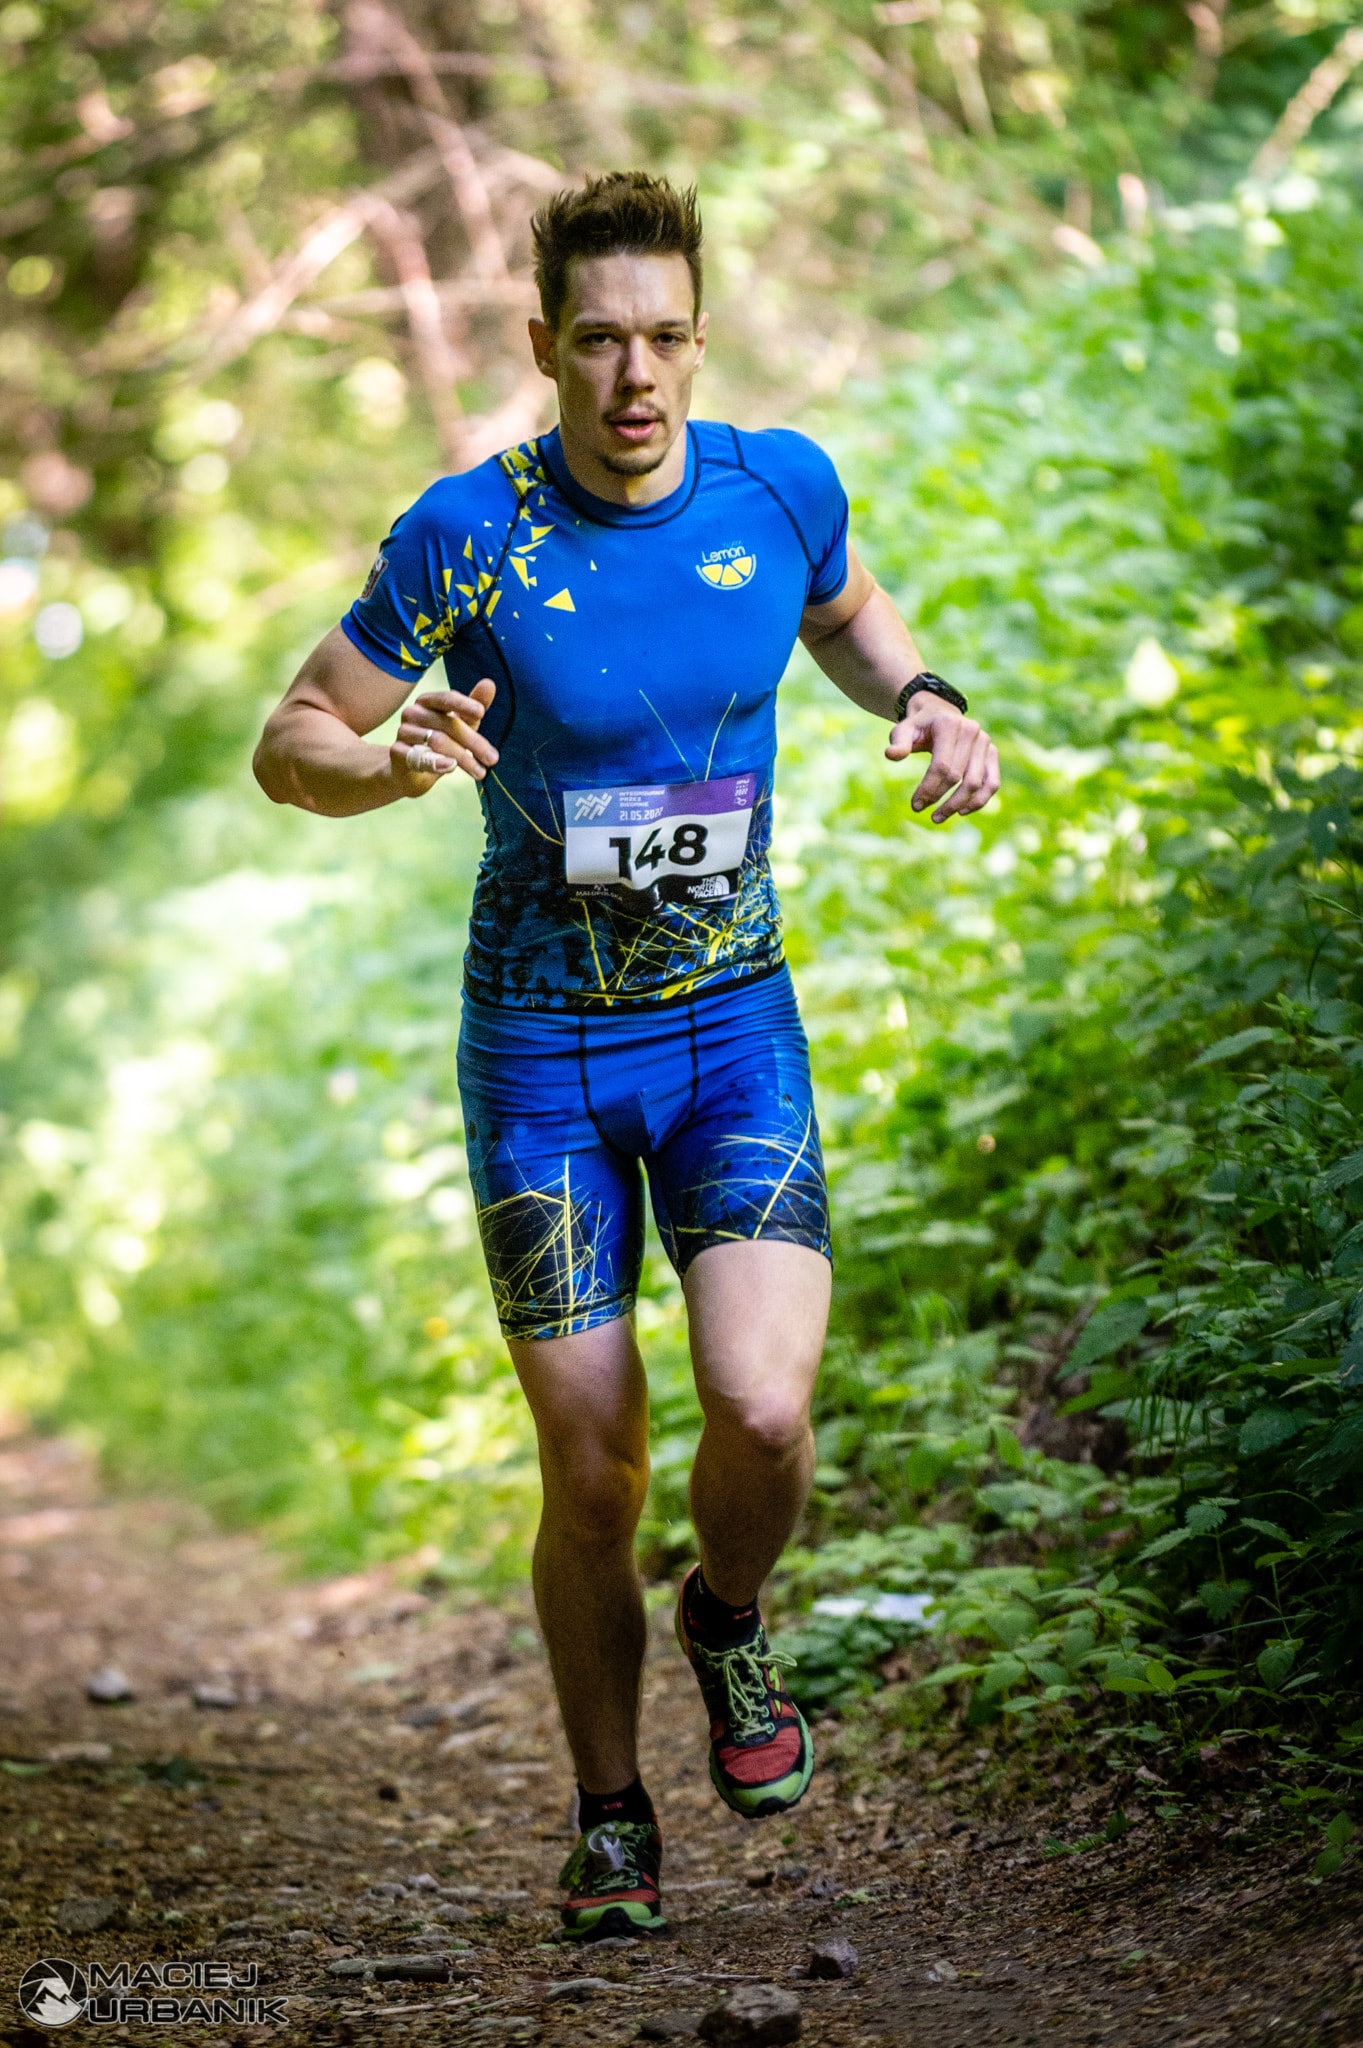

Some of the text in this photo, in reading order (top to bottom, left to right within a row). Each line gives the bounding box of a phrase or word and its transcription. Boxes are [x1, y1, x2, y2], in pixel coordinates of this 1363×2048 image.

[701, 545, 746, 564] Lemon
[609, 823, 708, 881] 148
[687, 881, 716, 894] NORTH
[702, 876, 717, 886] THE
[694, 889, 715, 899] FACE
